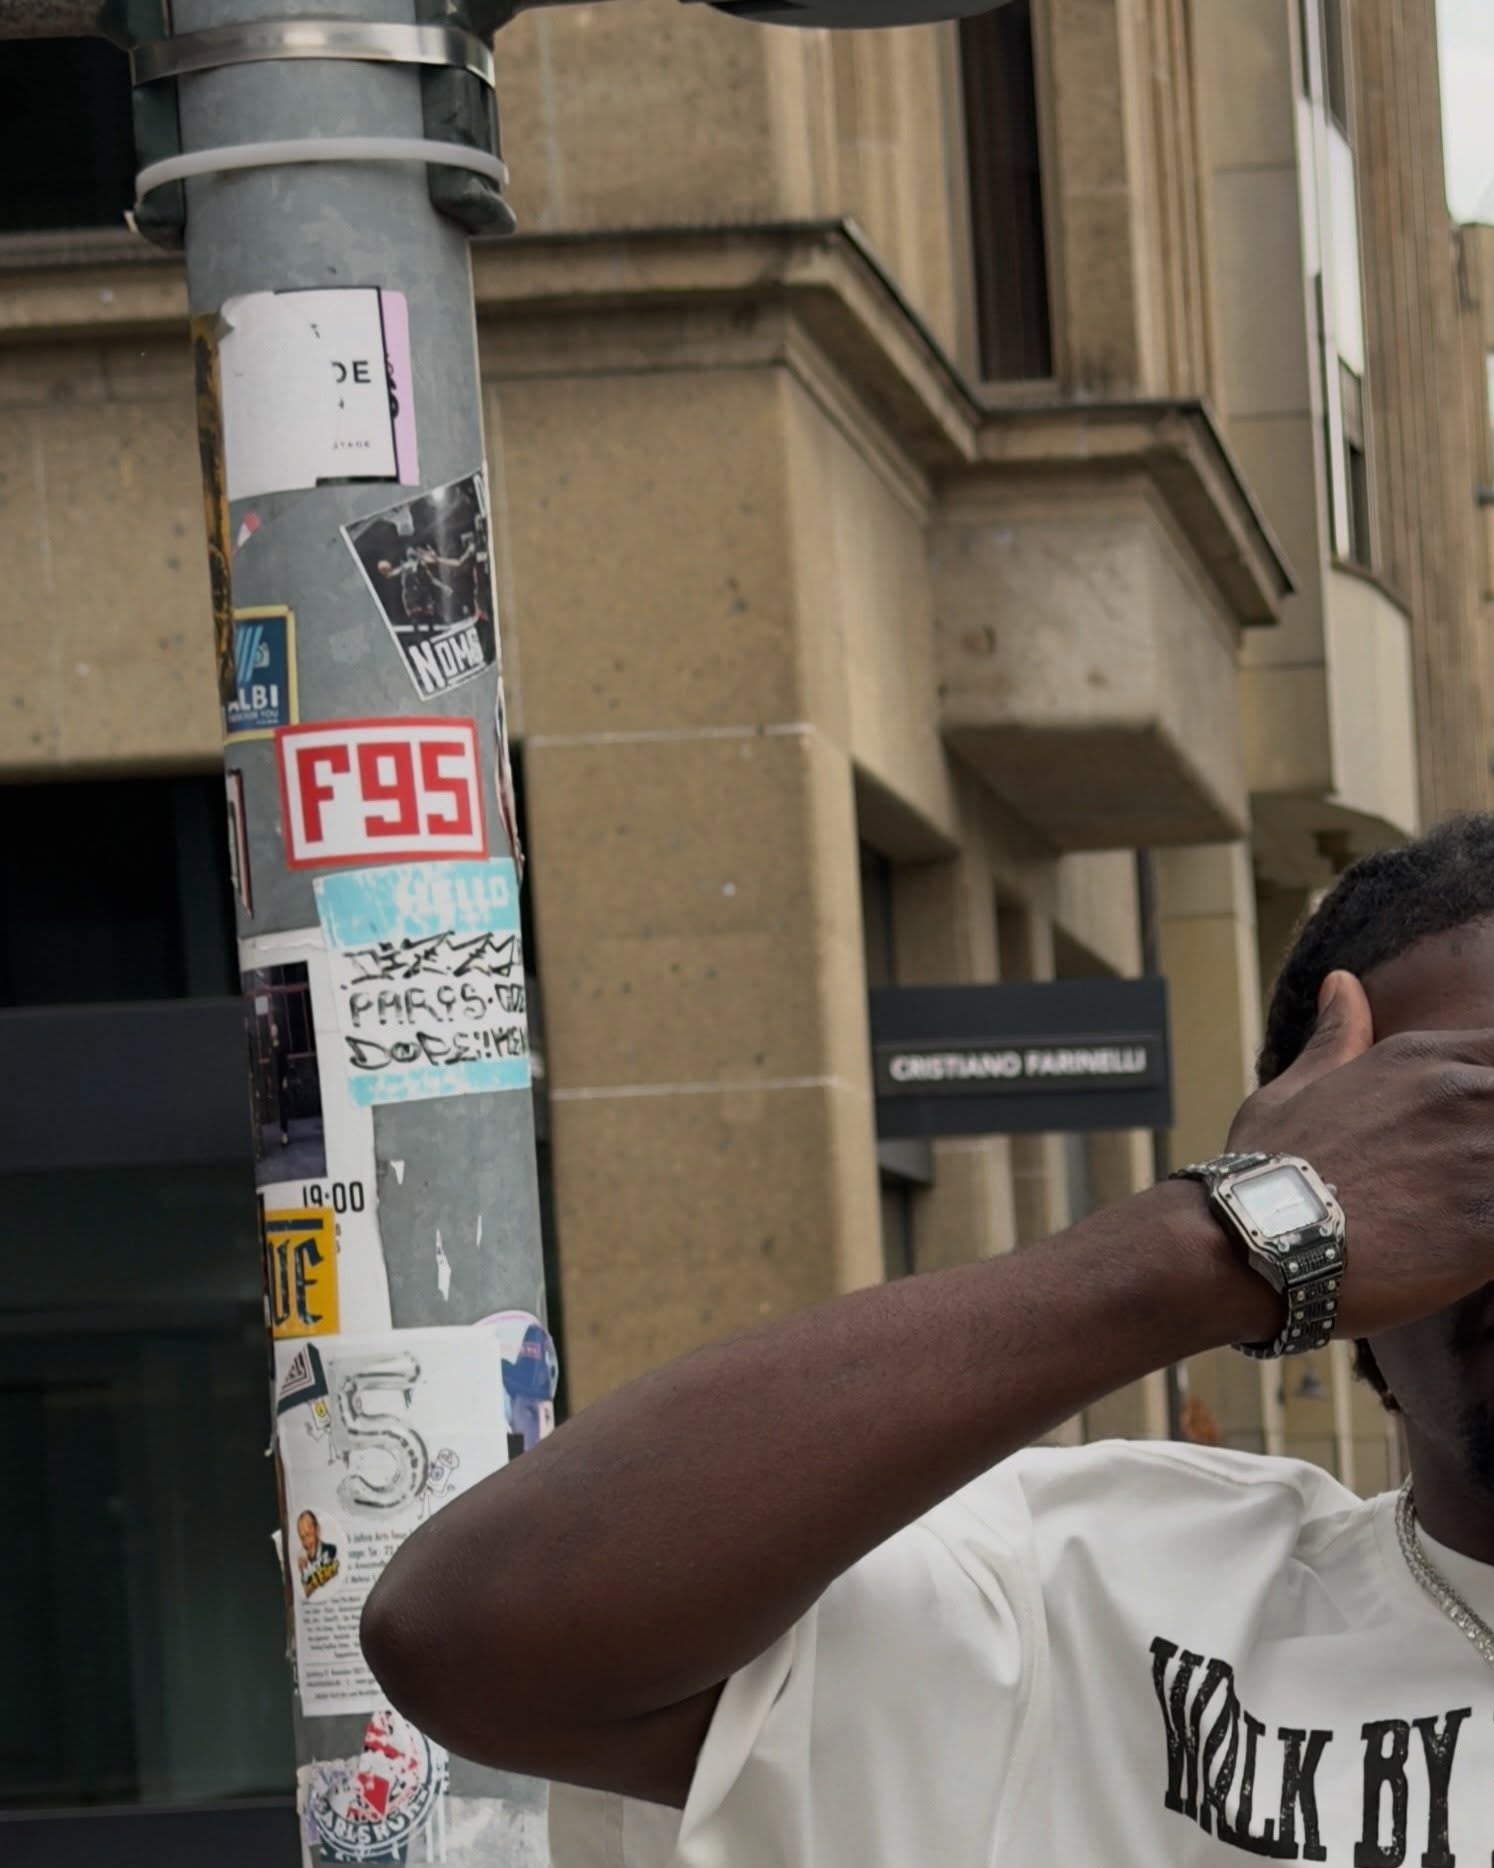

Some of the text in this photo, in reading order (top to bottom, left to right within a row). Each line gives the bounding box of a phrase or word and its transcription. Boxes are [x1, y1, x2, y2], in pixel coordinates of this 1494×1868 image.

[296, 741, 473, 843] F95
[890, 1047, 1146, 1081] CRISTIANO FARINELLI
[1150, 1636, 1334, 1862] WALK
